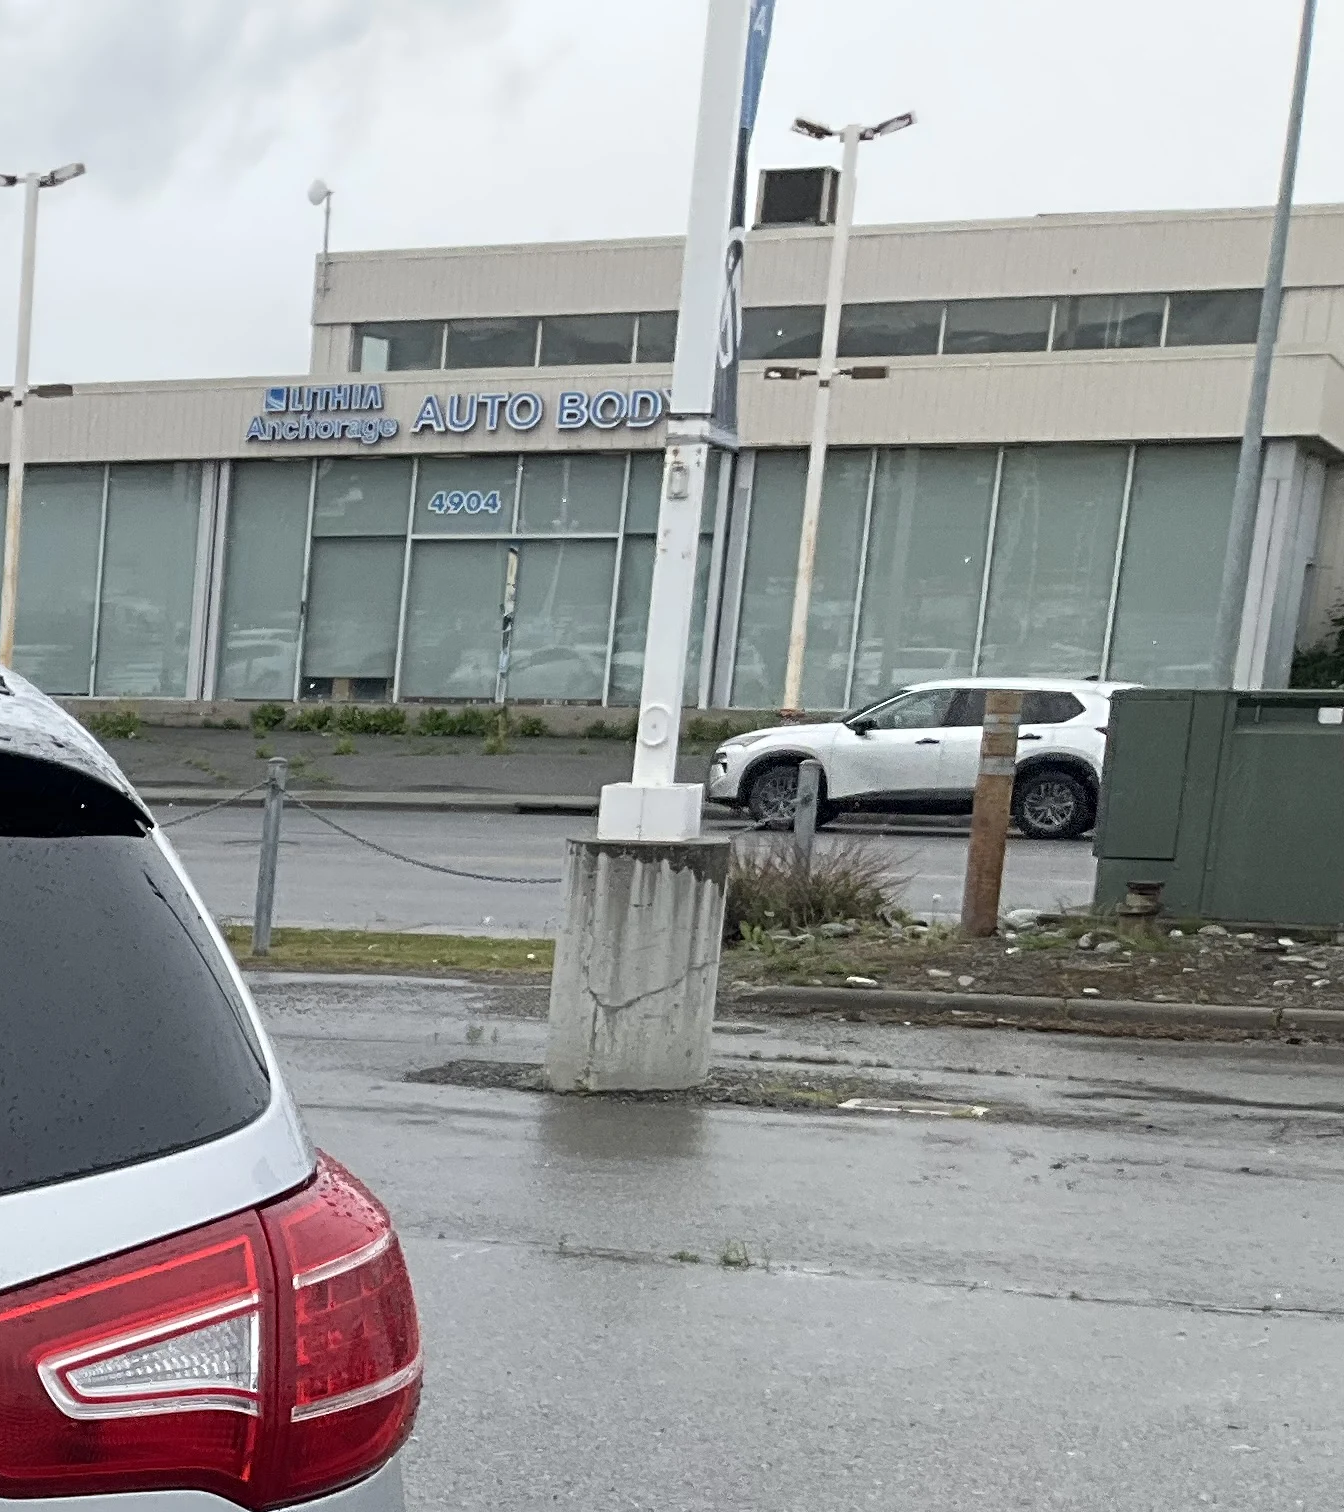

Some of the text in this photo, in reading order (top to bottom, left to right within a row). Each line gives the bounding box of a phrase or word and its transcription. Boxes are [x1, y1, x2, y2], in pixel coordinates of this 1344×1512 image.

[288, 383, 383, 411] LITHIA
[410, 388, 671, 433] AUTO BOD
[246, 413, 399, 445] Anchorage
[427, 490, 502, 515] 4904
